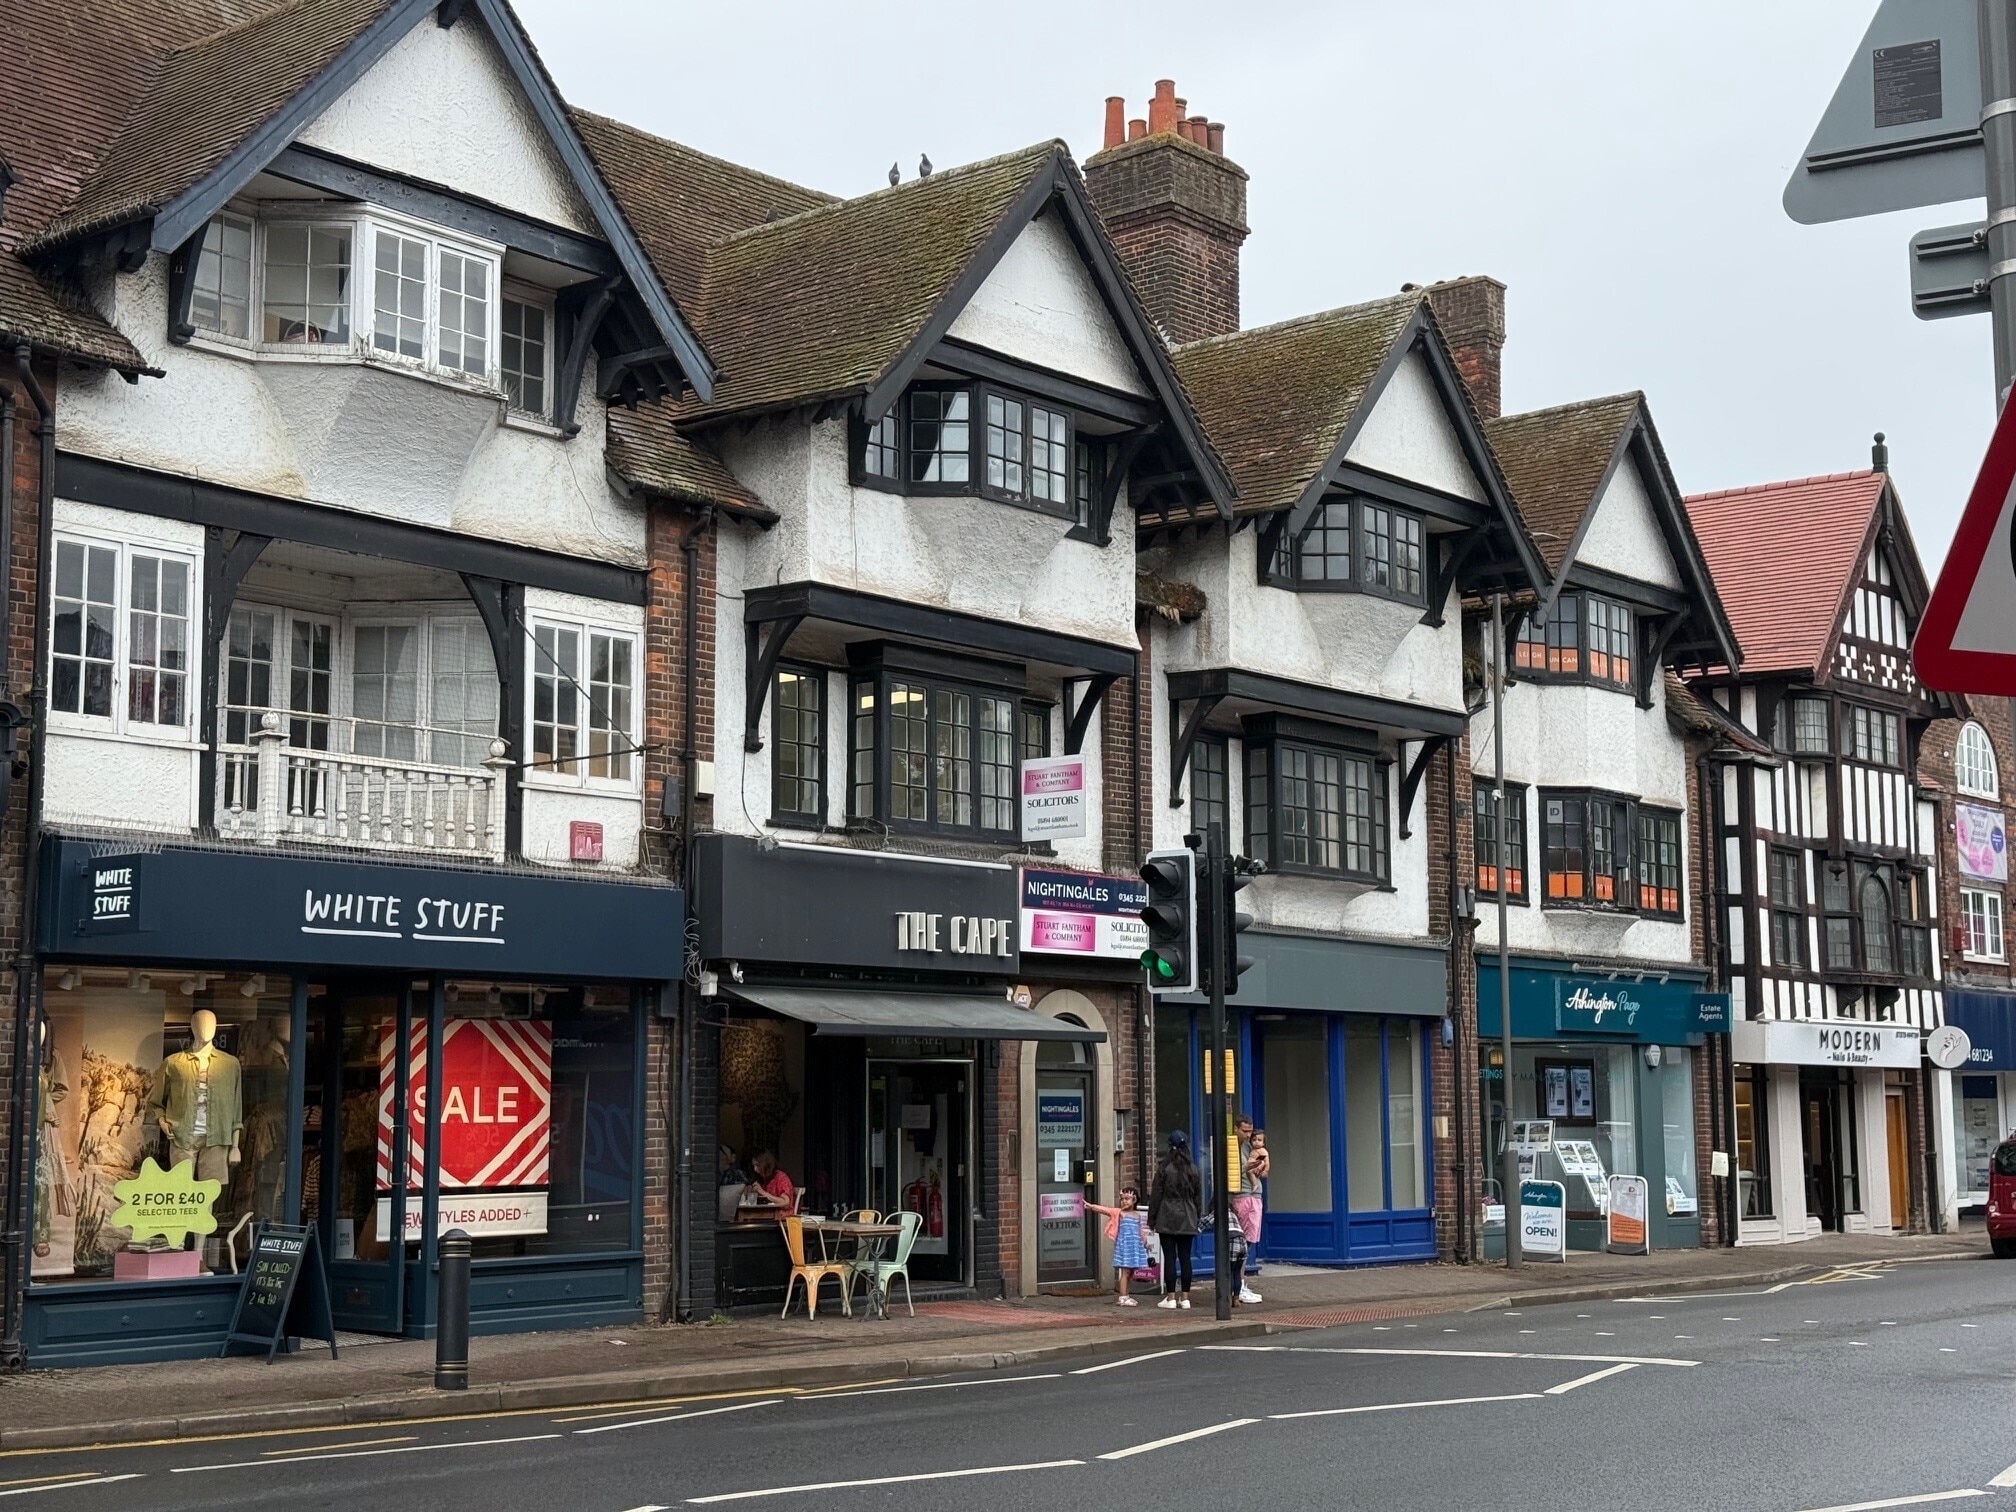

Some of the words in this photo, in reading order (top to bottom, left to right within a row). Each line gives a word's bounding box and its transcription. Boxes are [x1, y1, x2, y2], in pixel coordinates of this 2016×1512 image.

[1050, 770, 1078, 778] FANTHAM
[1042, 779, 1070, 787] COMPANY
[1027, 795, 1079, 808] SOLICITORS
[95, 868, 132, 887] WHITE
[1028, 881, 1109, 902] NIGHTINGALES
[1118, 892, 1134, 903] 0345
[93, 895, 131, 914] STUFF
[304, 889, 402, 928] WHITE
[413, 897, 505, 933] STUFF
[1036, 921, 1060, 930] STUART
[1061, 923, 1092, 932] FANTHAM
[1111, 921, 1147, 934] SOLICITO
[895, 911, 943, 952] THE
[950, 915, 1013, 957] CAPE
[1051, 932, 1082, 942] COMPANY
[1565, 987, 1617, 1024] Ashington
[1617, 990, 1641, 1026] Page
[1700, 1003, 1722, 1012] Estate
[1698, 1012, 1723, 1020] Agents
[1819, 1029, 1881, 1051] MODERN
[1832, 1052, 1846, 1062] Nails
[1851, 1053, 1868, 1065] Beauty
[1971, 1048, 1994, 1062] 681234
[1479, 1068, 1503, 1079] ETTINGS
[412, 1086, 519, 1124] SALE
[131, 1193, 140, 1205] 2
[145, 1194, 174, 1205] FOR
[178, 1192, 205, 1204] £40
[137, 1208, 177, 1216] SELECTED
[437, 1209, 476, 1224] TYLES
[478, 1208, 522, 1222] ADDED
[1042, 1221, 1081, 1230] SOLICITORS
[1525, 1226, 1557, 1237] OPEN!
[259, 1238, 281, 1250] WHITE
